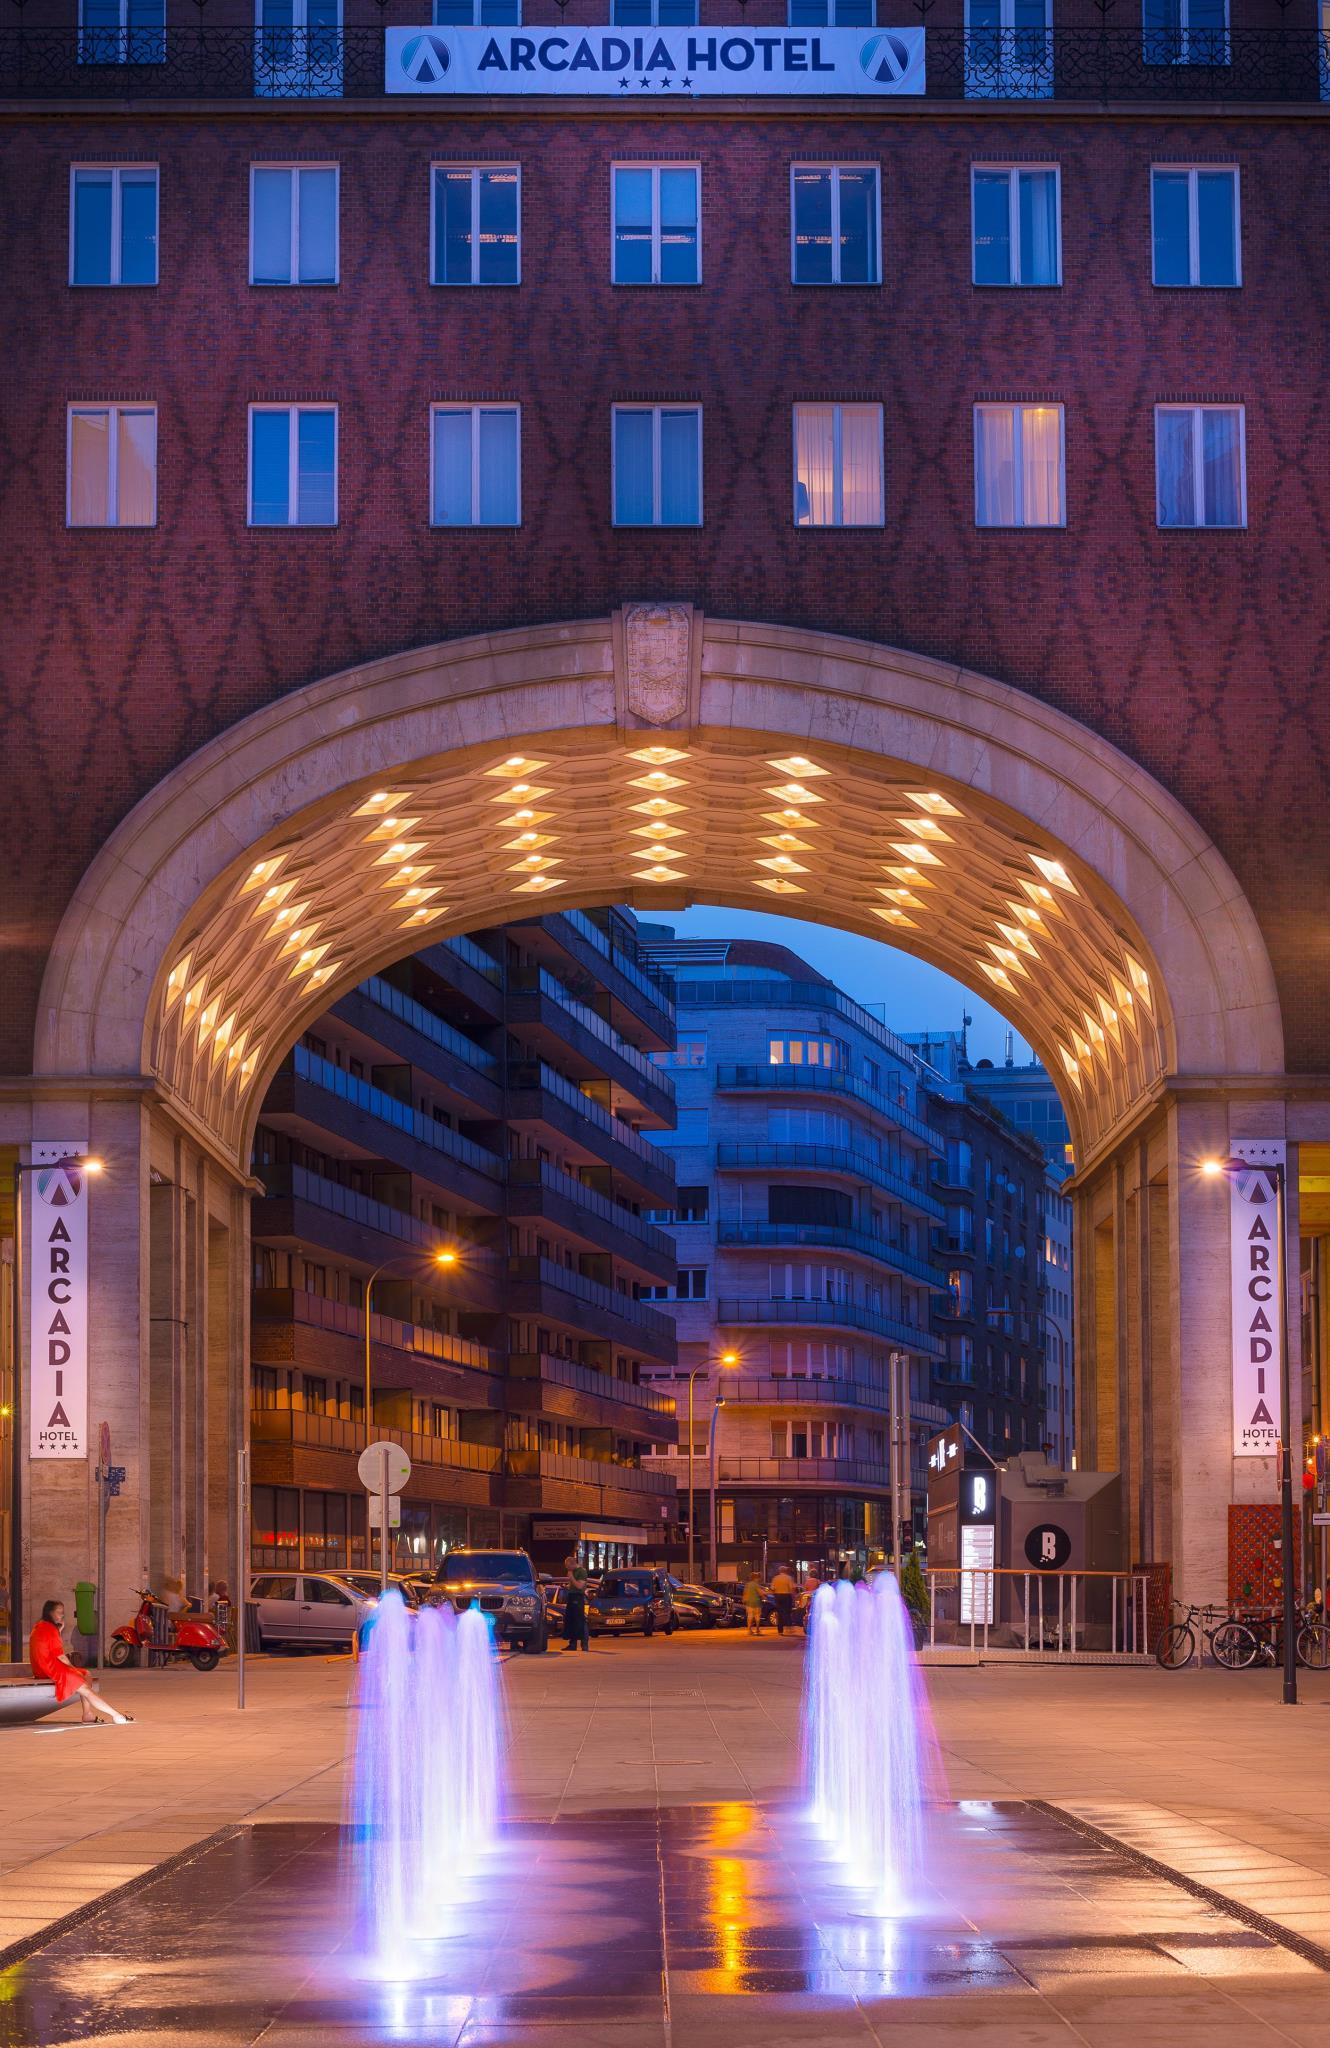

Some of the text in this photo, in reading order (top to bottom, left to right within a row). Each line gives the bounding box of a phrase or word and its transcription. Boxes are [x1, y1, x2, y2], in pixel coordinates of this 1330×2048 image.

[476, 37, 835, 72] ARCADIA HOTEL
[47, 1216, 72, 1428] ARCADIA
[1247, 1213, 1274, 1425] ARCADIA
[39, 1431, 78, 1441] HOTEL
[1242, 1429, 1281, 1439] HOTEL
